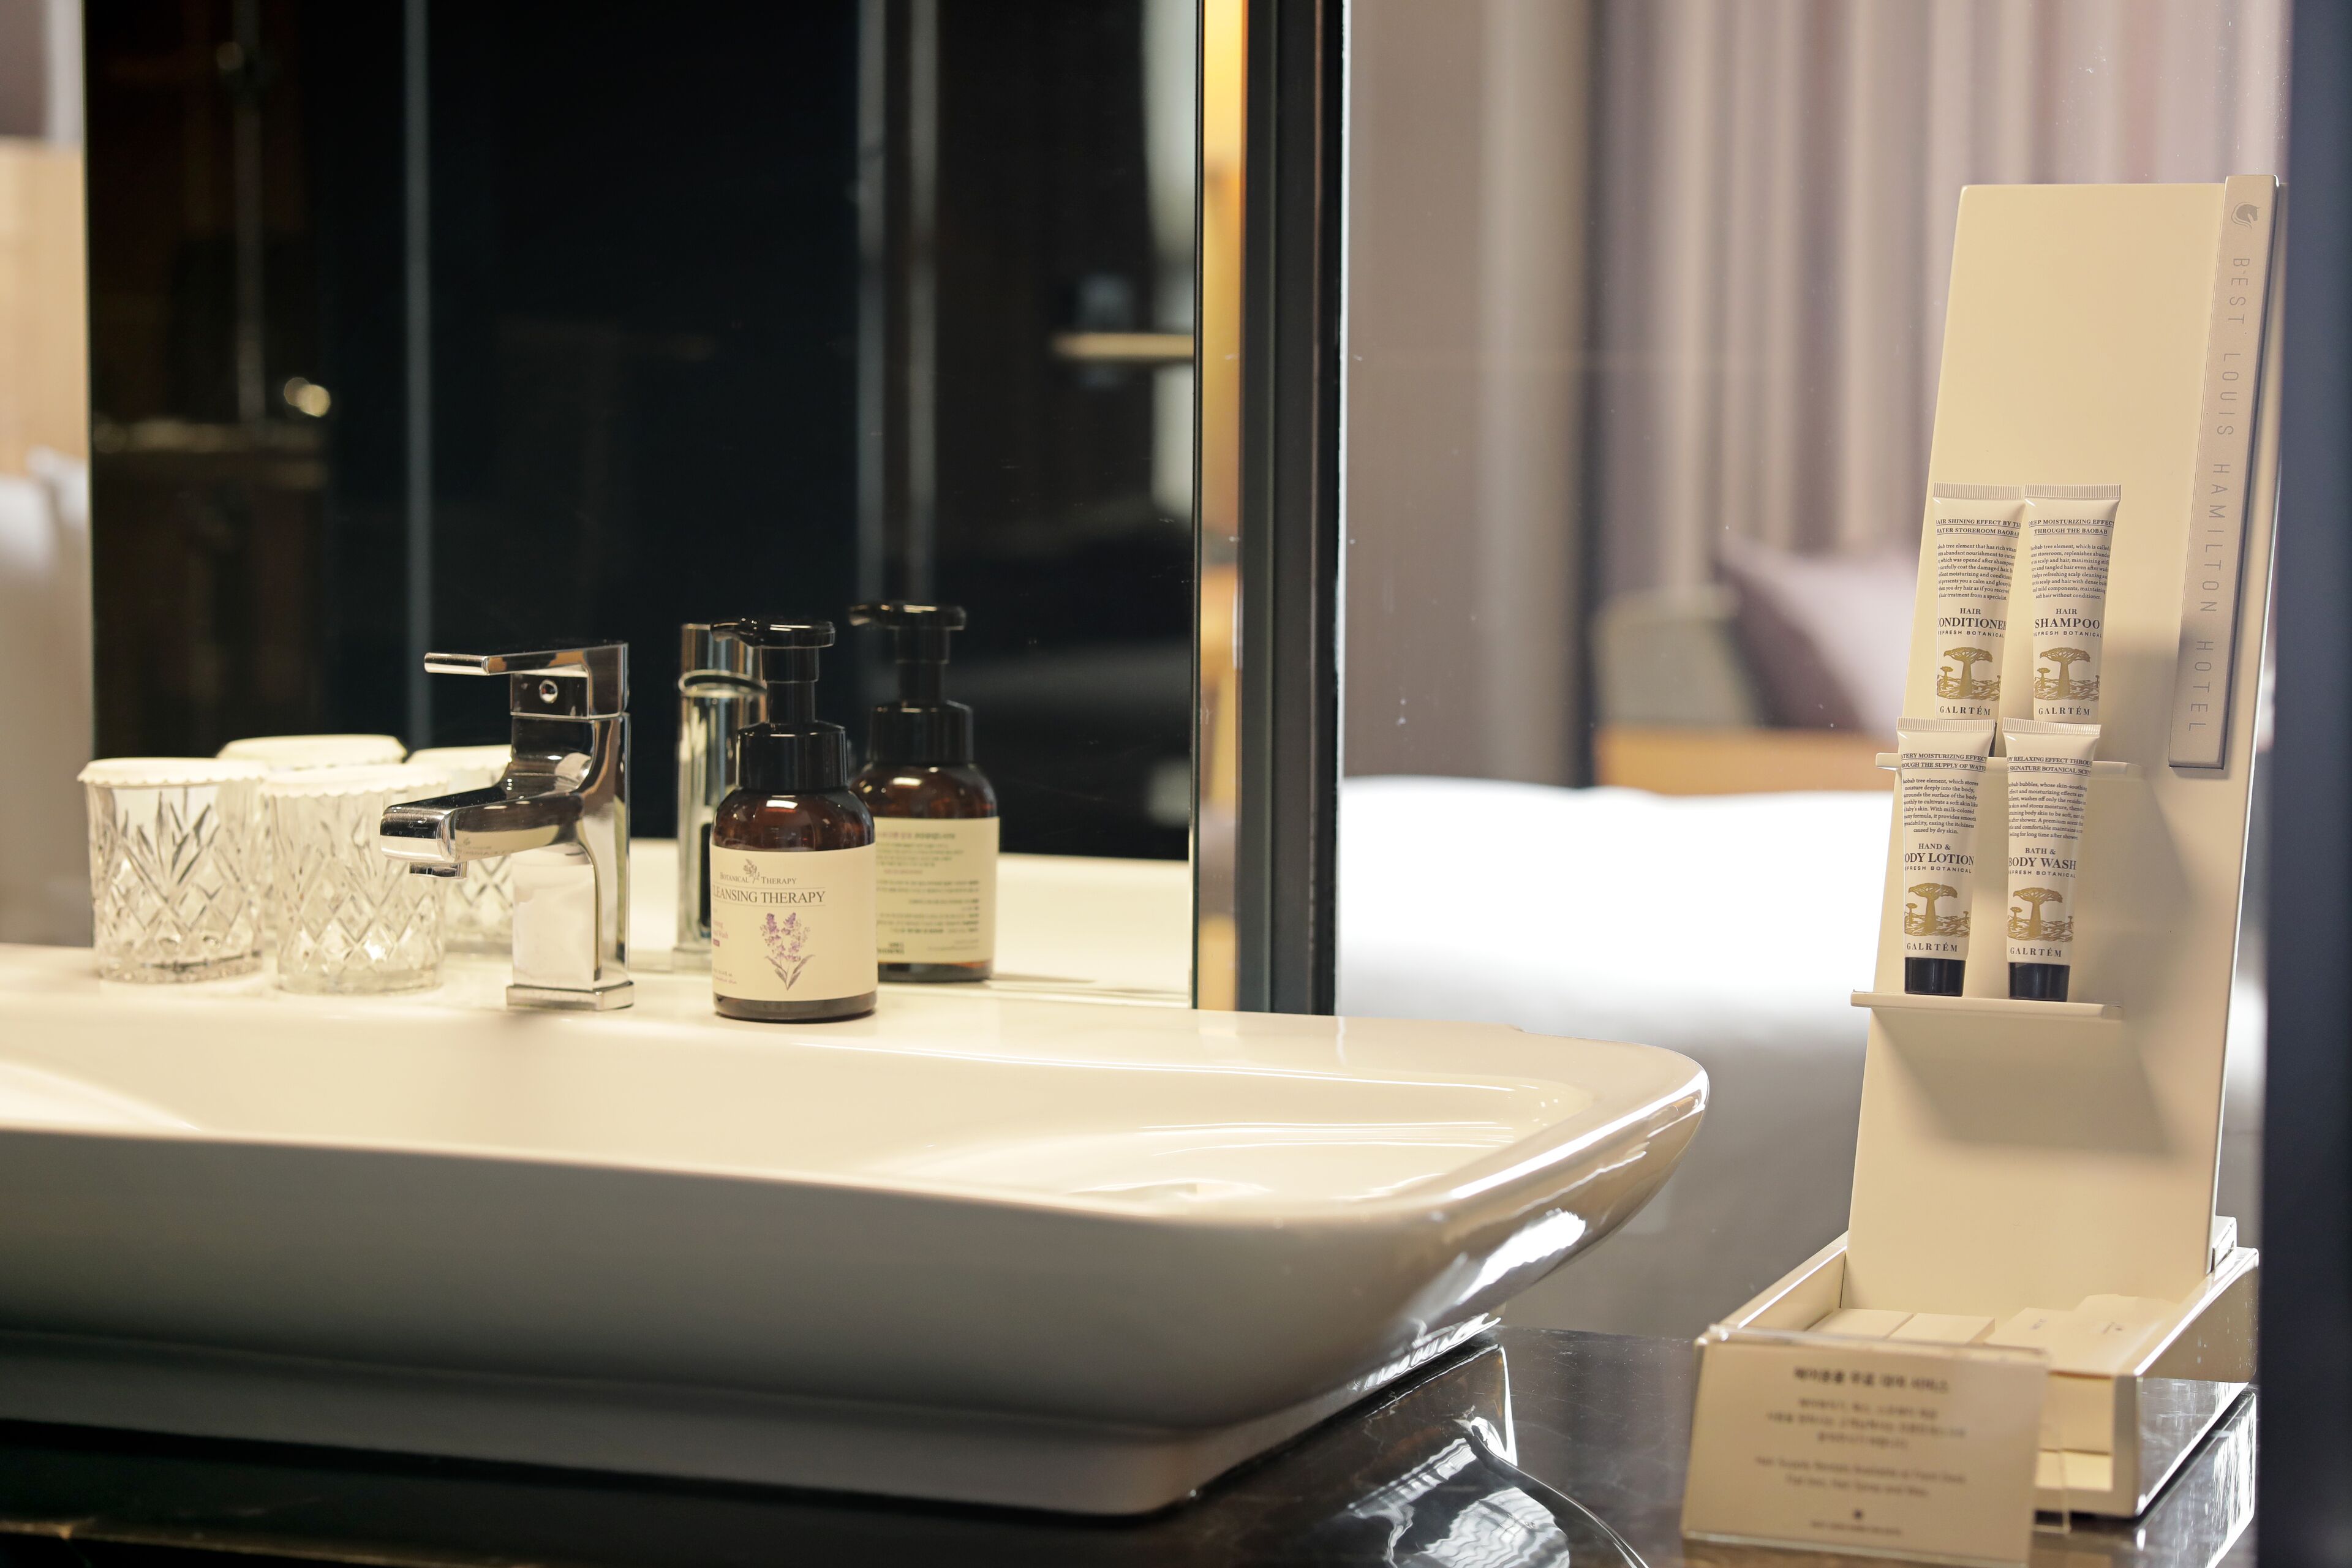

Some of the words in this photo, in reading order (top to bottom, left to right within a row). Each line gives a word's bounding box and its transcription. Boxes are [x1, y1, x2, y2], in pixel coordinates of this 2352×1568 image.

[2227, 258, 2250, 324] BEST
[2217, 353, 2241, 435] LOUIS
[2199, 464, 2231, 612] HAMILTON
[1938, 617, 2007, 630] ONDITIONE
[2035, 618, 2100, 629] SHAMPOO
[2189, 641, 2214, 731] HOTEL
[1928, 853, 1974, 865] LOTION
[2041, 858, 2076, 870] WASH
[720, 872, 749, 883] BOTANICAL
[761, 891, 826, 903] THERAPY
